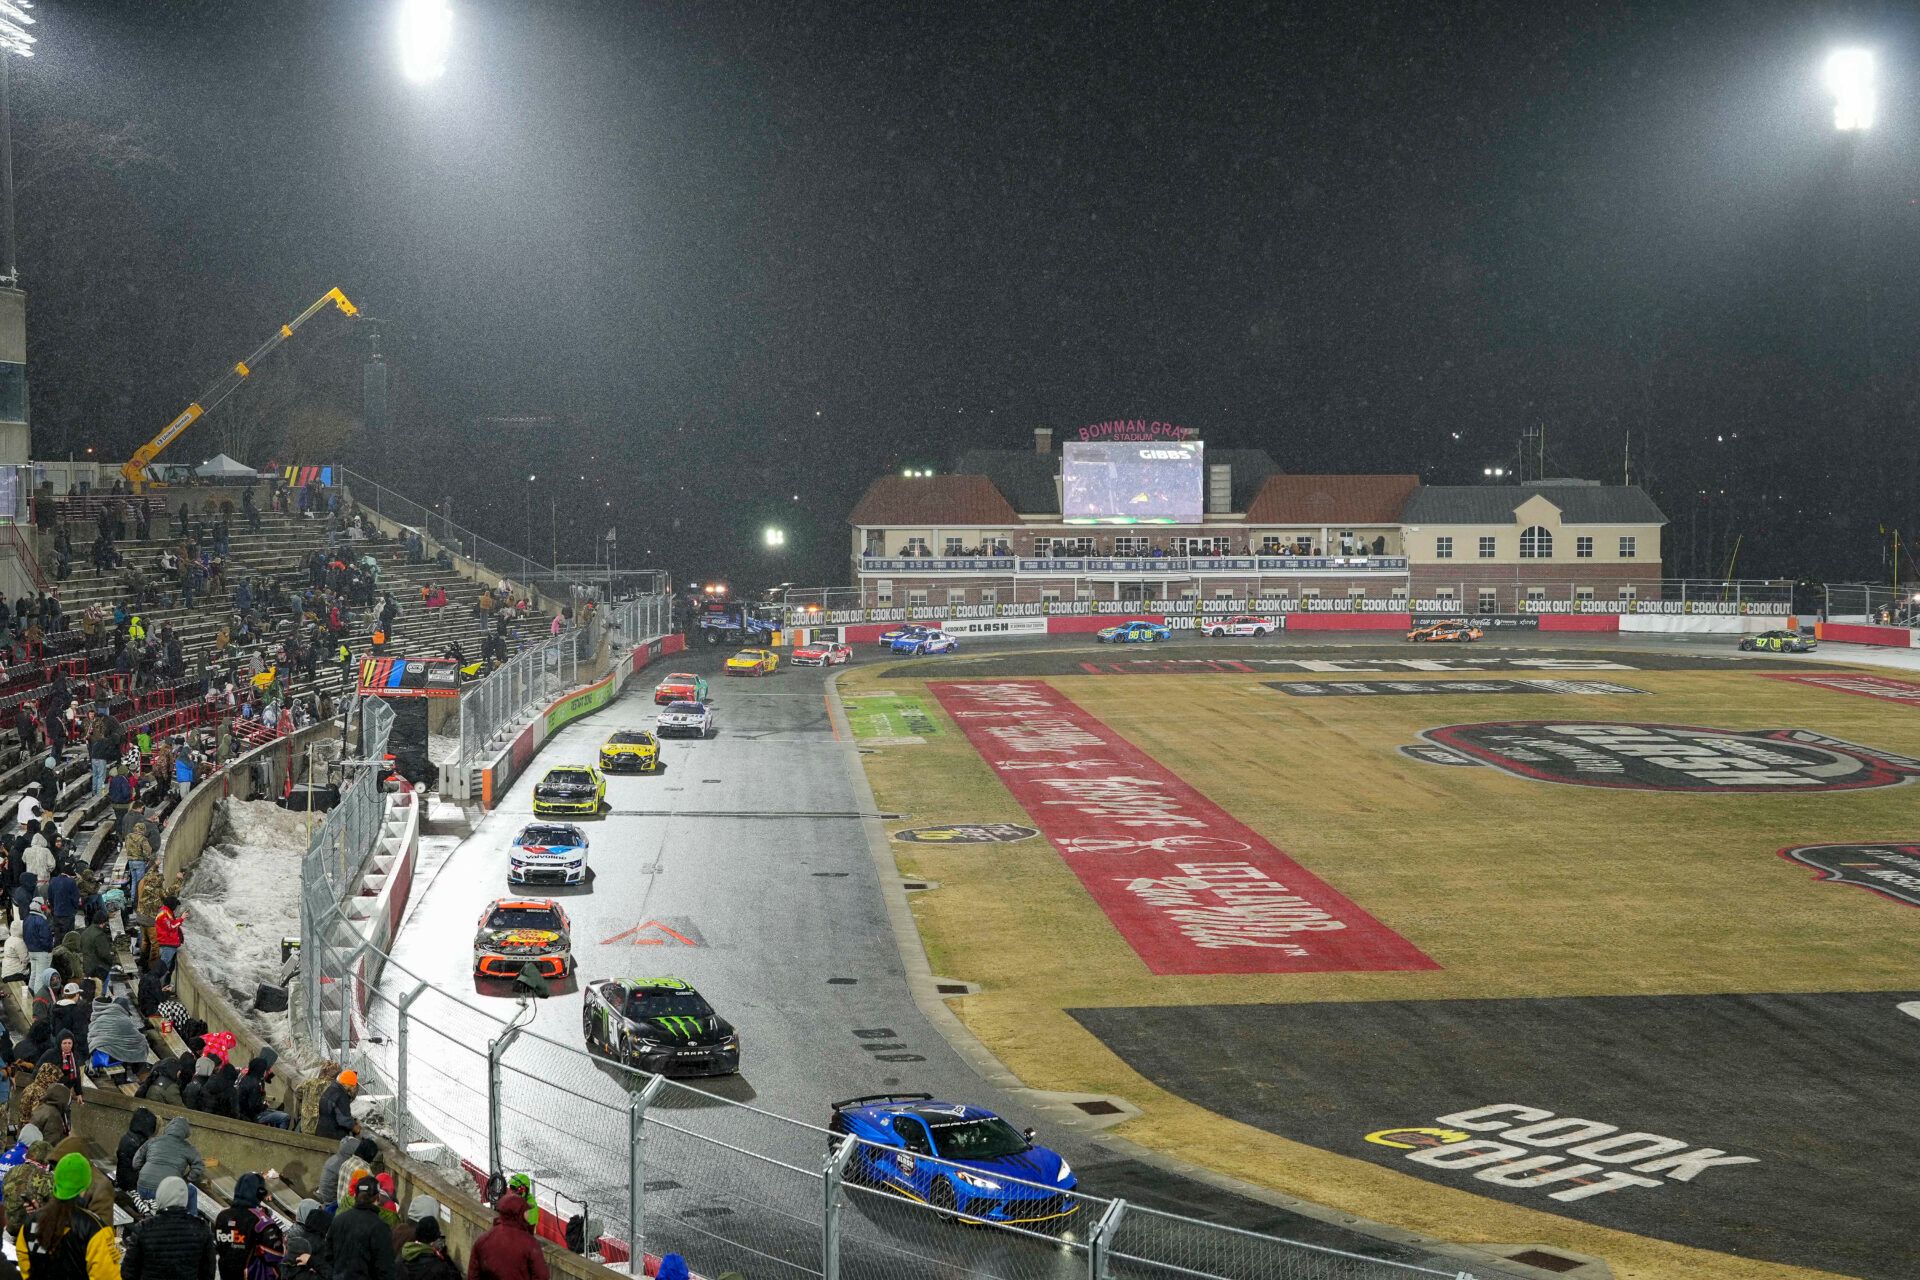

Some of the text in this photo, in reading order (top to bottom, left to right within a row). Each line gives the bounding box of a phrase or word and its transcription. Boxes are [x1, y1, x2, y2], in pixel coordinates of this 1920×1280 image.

[1079, 420, 1191, 441] BOWMAN GRAY
[1113, 433, 1153, 441] STADIUM
[1139, 450, 1191, 460] GIBBS
[957, 604, 994, 618] COOK OUT
[1002, 602, 1041, 616] COOK OUT
[1049, 601, 1090, 614] COOK OUT
[1100, 600, 1140, 613] COOK OUT
[1151, 600, 1194, 612] COOK OUT
[1203, 600, 1245, 612] COOK OUT
[1255, 599, 1299, 612] COOK OUT
[1308, 599, 1352, 611] COOK OUT
[1362, 599, 1407, 611] COOK OUT
[1416, 600, 1461, 611] COOK OUT
[1525, 600, 1572, 612] COOK OUT
[1581, 600, 1627, 612] COOK OUT
[1637, 601, 1683, 613] COOK OUT
[1692, 602, 1737, 614] COOK OUT
[1746, 602, 1791, 615] COOK OUT
[790, 612, 824, 625] COOK OUT
[832, 609, 864, 623] COOK OUT
[871, 607, 905, 621] COOK OUT
[913, 605, 949, 619] COOK OUT
[968, 623, 1009, 632] CLASH
[1165, 617, 1196, 630] COOK
[1128, 630, 1139, 639] 88
[1756, 639, 1768, 647] 97
[1544, 725, 1826, 784] CLASH
[1175, 862, 1270, 880] LET
[930, 1116, 999, 1129] CORVETTE
[1436, 1103, 1761, 1182] COOK
[1405, 1140, 1665, 1201] OUT
[215, 1229, 246, 1243] FedEx
